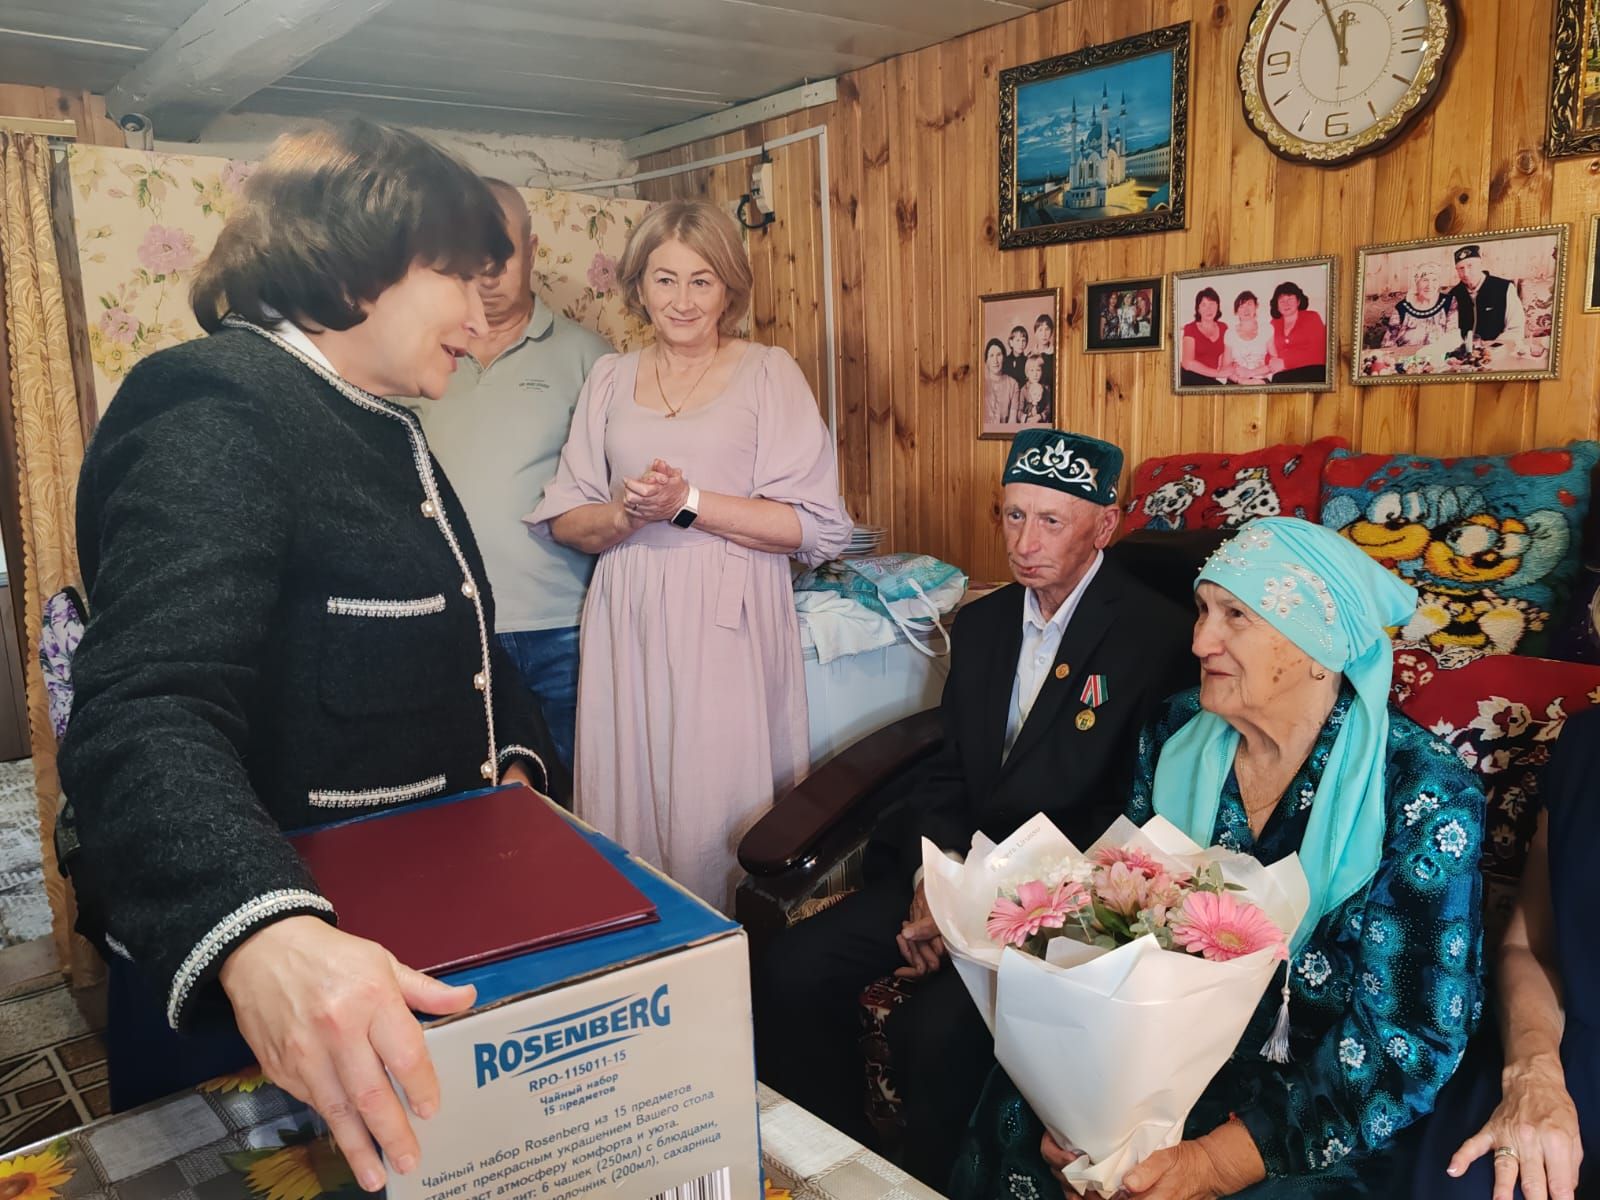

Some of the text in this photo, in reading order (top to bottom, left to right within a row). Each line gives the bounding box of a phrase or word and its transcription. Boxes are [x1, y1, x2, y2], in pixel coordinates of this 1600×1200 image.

[1267, 51, 1291, 77] 9
[1324, 111, 1349, 137] 6
[473, 983, 671, 1089] ROSENBERG
[529, 1049, 627, 1092] RPO-115011-15
[540, 1073, 619, 1105] Чайный набор
[544, 1086, 616, 1116] 15 предметов
[422, 1084, 692, 1188] Чайный набор Rosenberg из 15 предметов
[473, 1153, 553, 1188] прекрасным
[557, 1121, 632, 1157] украшением
[636, 1104, 679, 1126] Вашего
[683, 1090, 715, 1109] стола
[497, 1161, 567, 1195] атмосферу
[572, 1134, 633, 1166] комфорта
[637, 1129, 644, 1140] и
[649, 1118, 679, 1138] уюта.
[542, 1181, 550, 1193] 6
[554, 1169, 592, 1188] чашек
[596, 1146, 642, 1173] (250мл)
[646, 1143, 653, 1152] с
[656, 1120, 718, 1148] блюдцами,
[663, 1131, 721, 1160] сахарница
